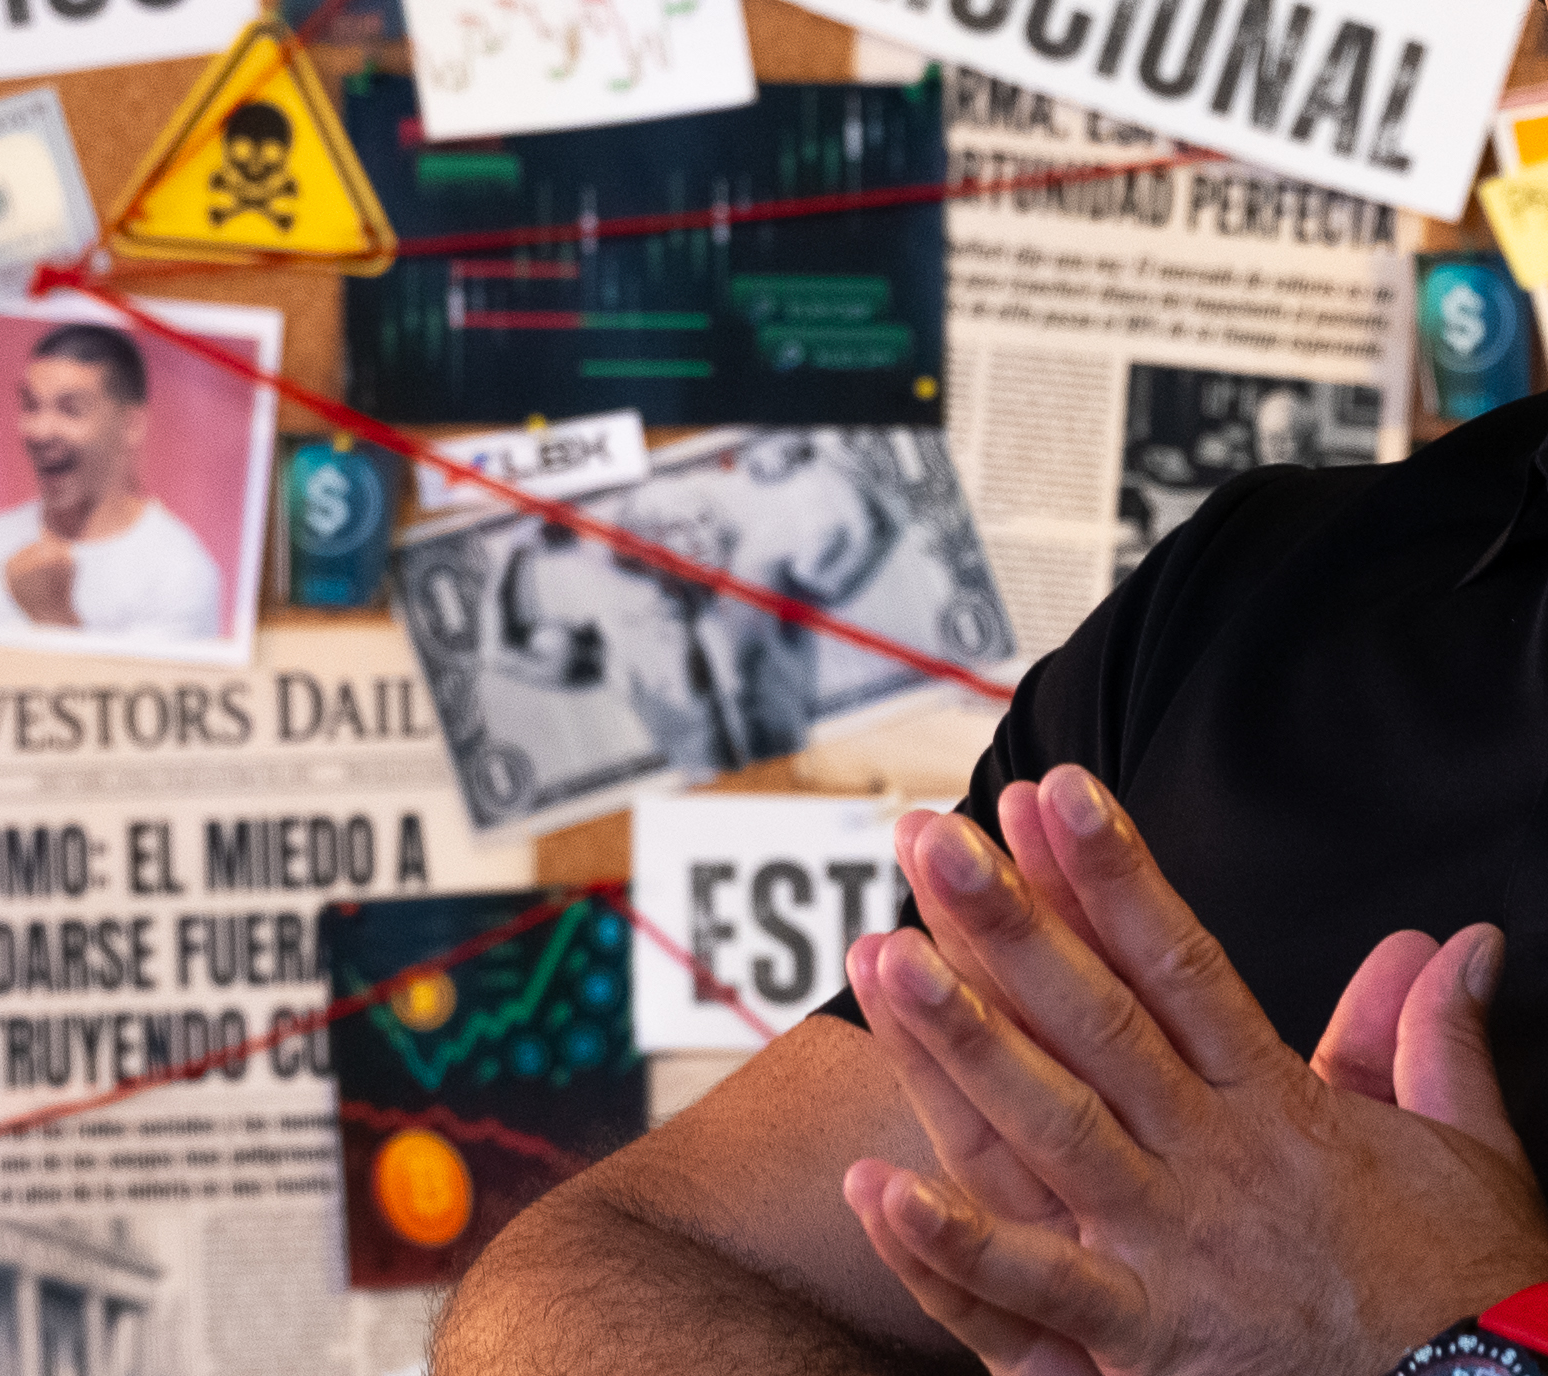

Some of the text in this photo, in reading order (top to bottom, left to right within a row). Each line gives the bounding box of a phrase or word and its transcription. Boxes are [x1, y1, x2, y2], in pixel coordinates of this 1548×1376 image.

[499, 432, 610, 482] LBX
[129, 821, 185, 896] EL
[205, 814, 375, 890] MIEDO
[397, 813, 428, 885] A
[177, 914, 332, 988] FUERA
